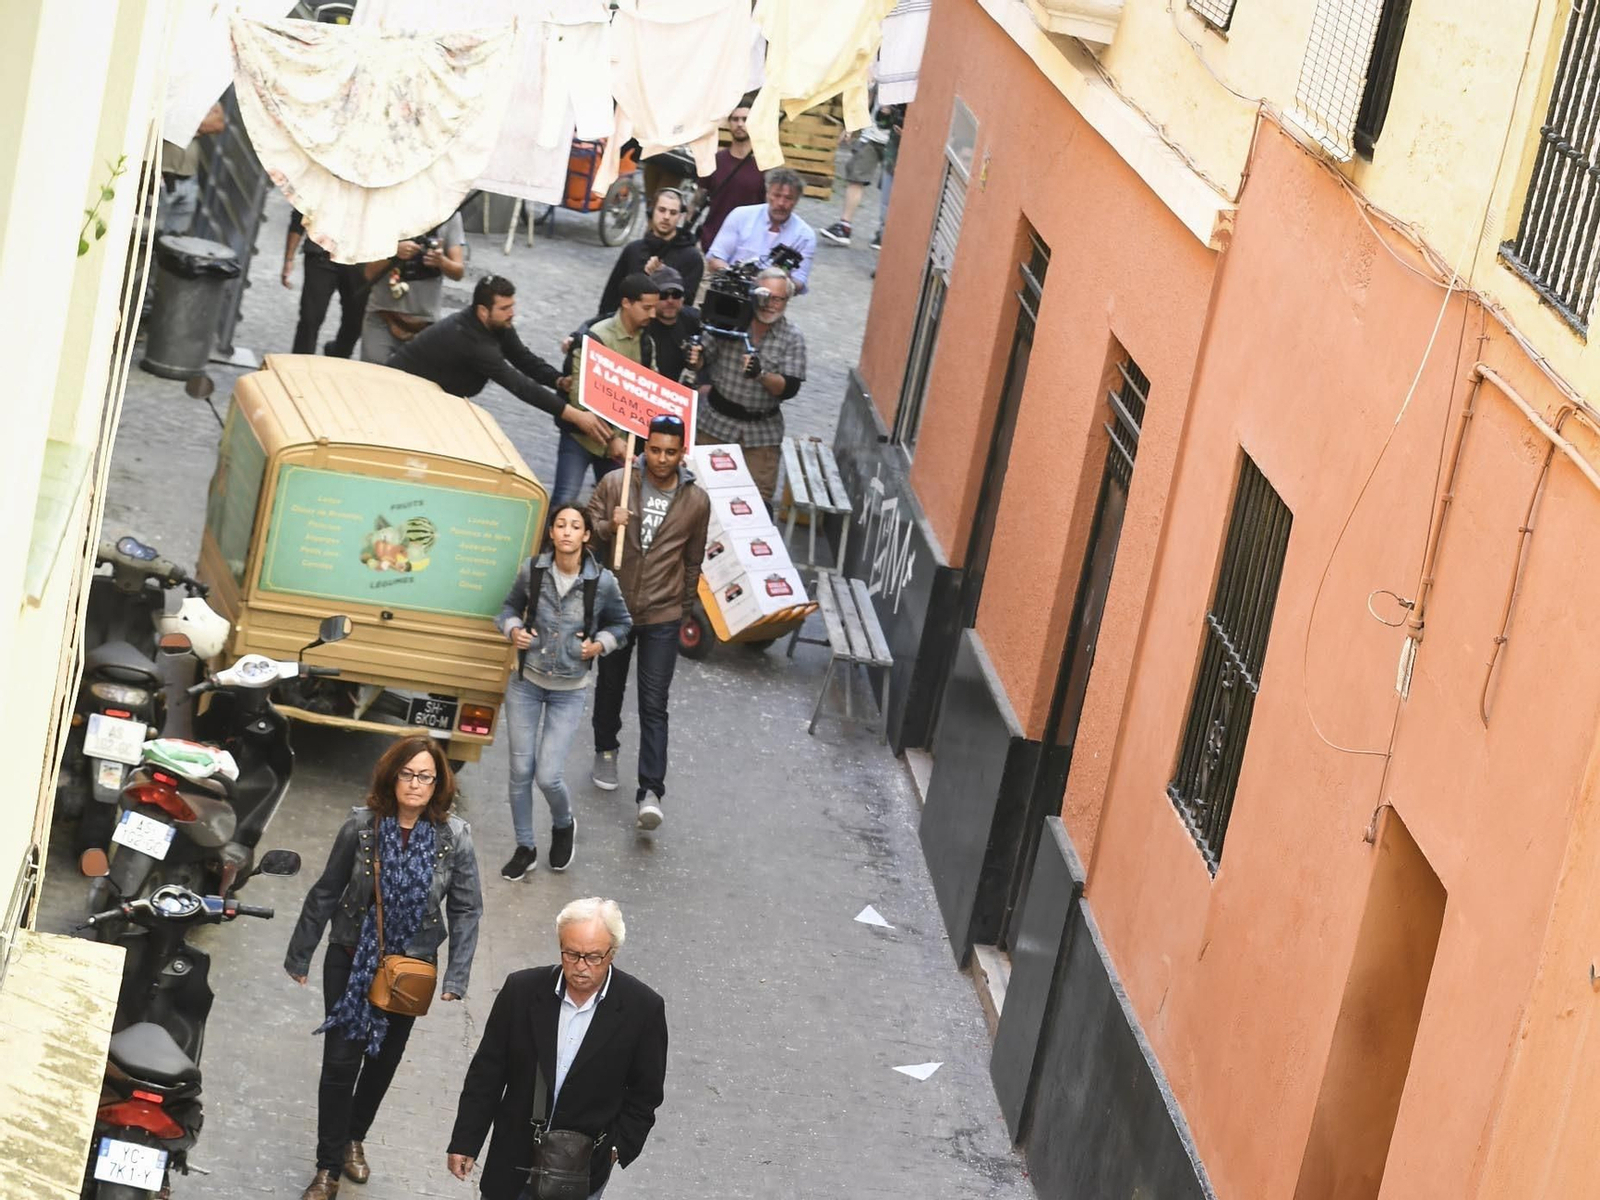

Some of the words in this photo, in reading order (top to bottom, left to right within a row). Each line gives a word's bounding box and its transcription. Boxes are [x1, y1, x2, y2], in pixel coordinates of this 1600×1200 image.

[603, 371, 620, 386] LA
[621, 379, 684, 416] VIOLENCE
[660, 386, 690, 408] NON
[612, 402, 626, 417] LA
[390, 500, 424, 510] FRUITS
[110, 1161, 151, 1185] 7K1-Y
